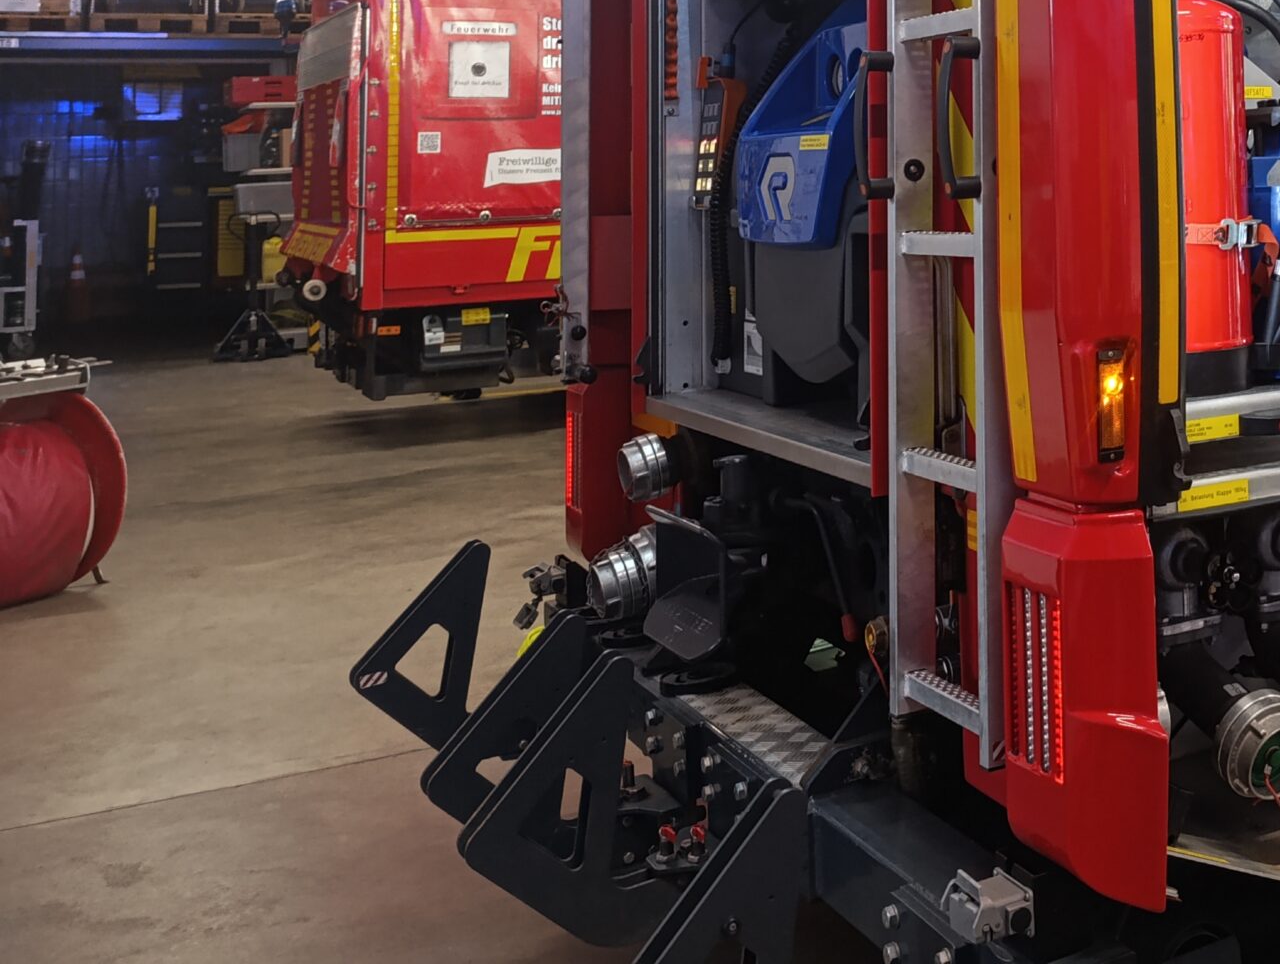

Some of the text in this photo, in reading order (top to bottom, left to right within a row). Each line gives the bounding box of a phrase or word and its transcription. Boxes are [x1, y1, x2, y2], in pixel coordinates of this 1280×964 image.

[450, 23, 510, 33] Feuerwehr
[542, 95, 562, 105] MIT
[498, 157, 558, 168] Freiwillige
